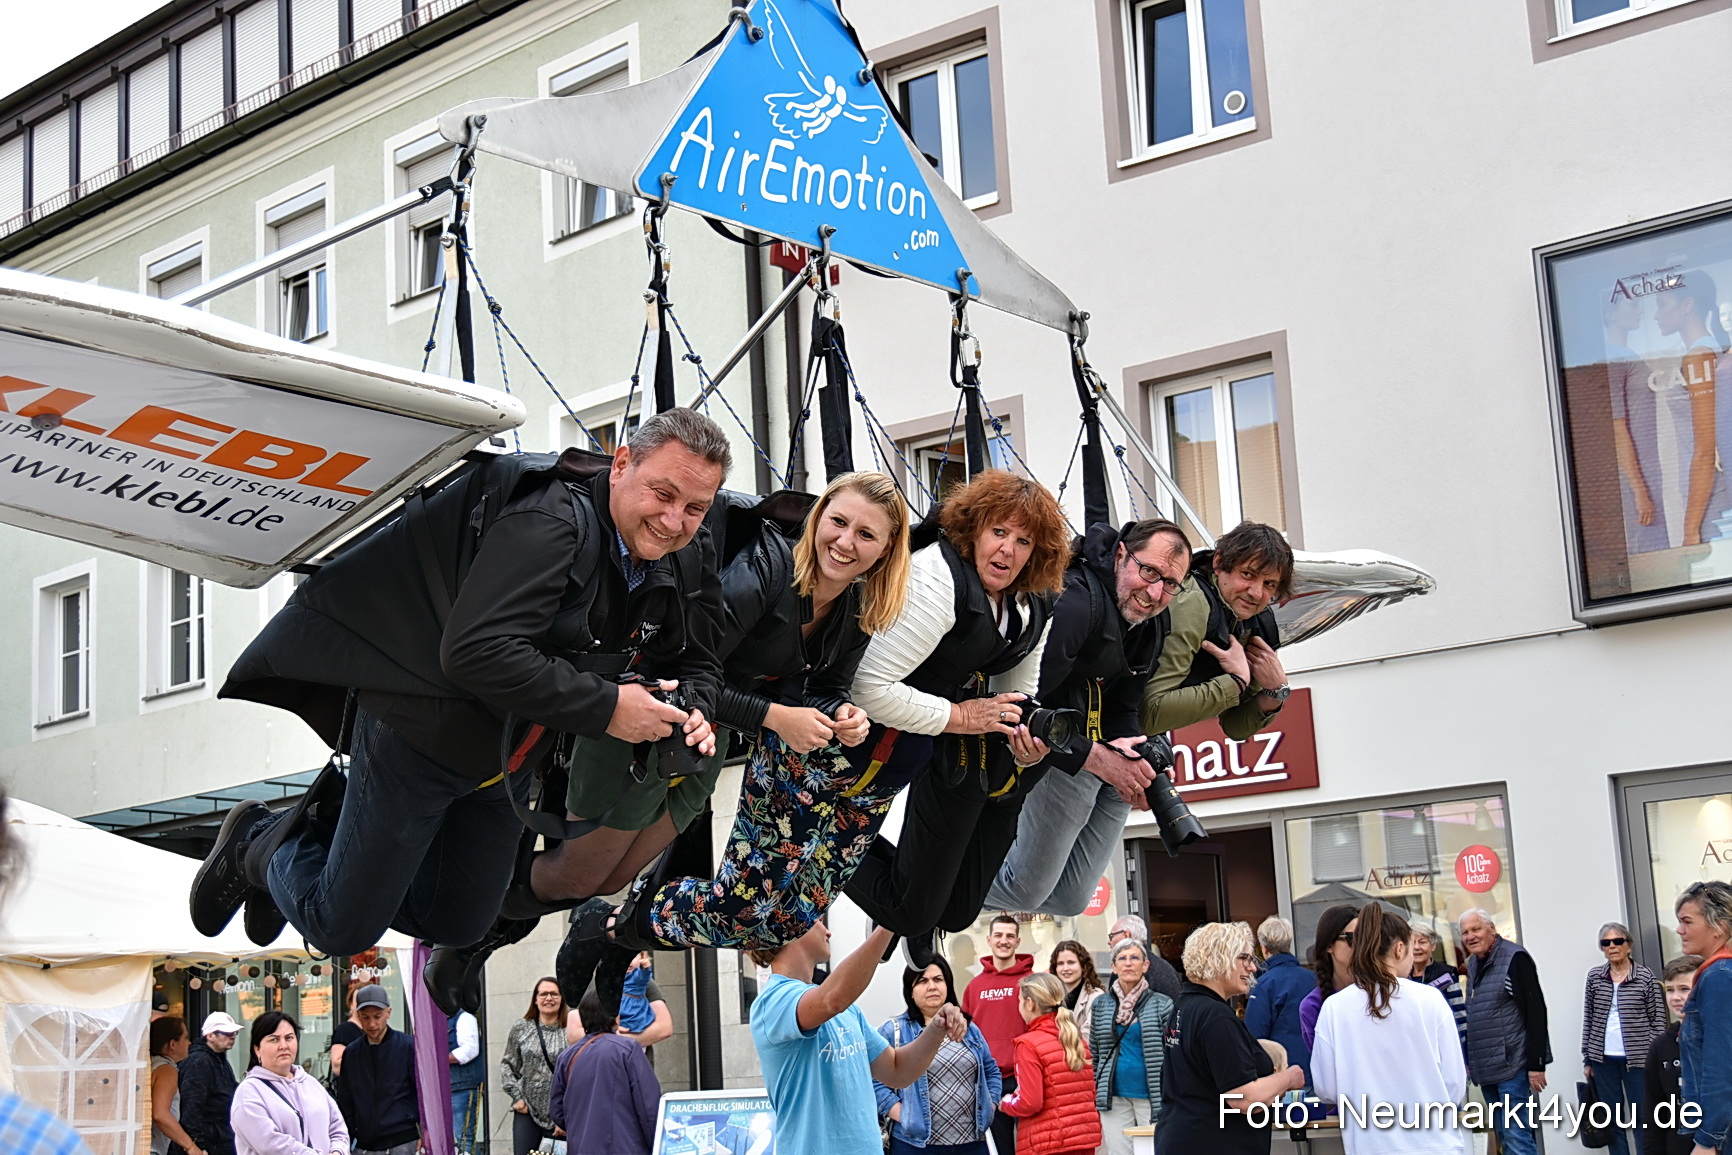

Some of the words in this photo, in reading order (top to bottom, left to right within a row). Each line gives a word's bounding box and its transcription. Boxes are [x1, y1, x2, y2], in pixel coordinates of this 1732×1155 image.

[669, 106, 926, 219] AirEmotion
[903, 229, 939, 250] .com
[1610, 273, 1684, 303] Achatz
[1647, 359, 1718, 392] CALI
[0, 453, 285, 531] ww.klebl.de
[142, 457, 175, 473] IN
[177, 466, 357, 512] DEUTSCHLAND
[1166, 730, 1285, 781] hatz
[1364, 867, 1432, 891] Achatz
[1466, 872, 1490, 885] Achatz
[980, 987, 1014, 1000] ELEVATE
[669, 1100, 773, 1113] DRACHENFLUG-SIMULATO
